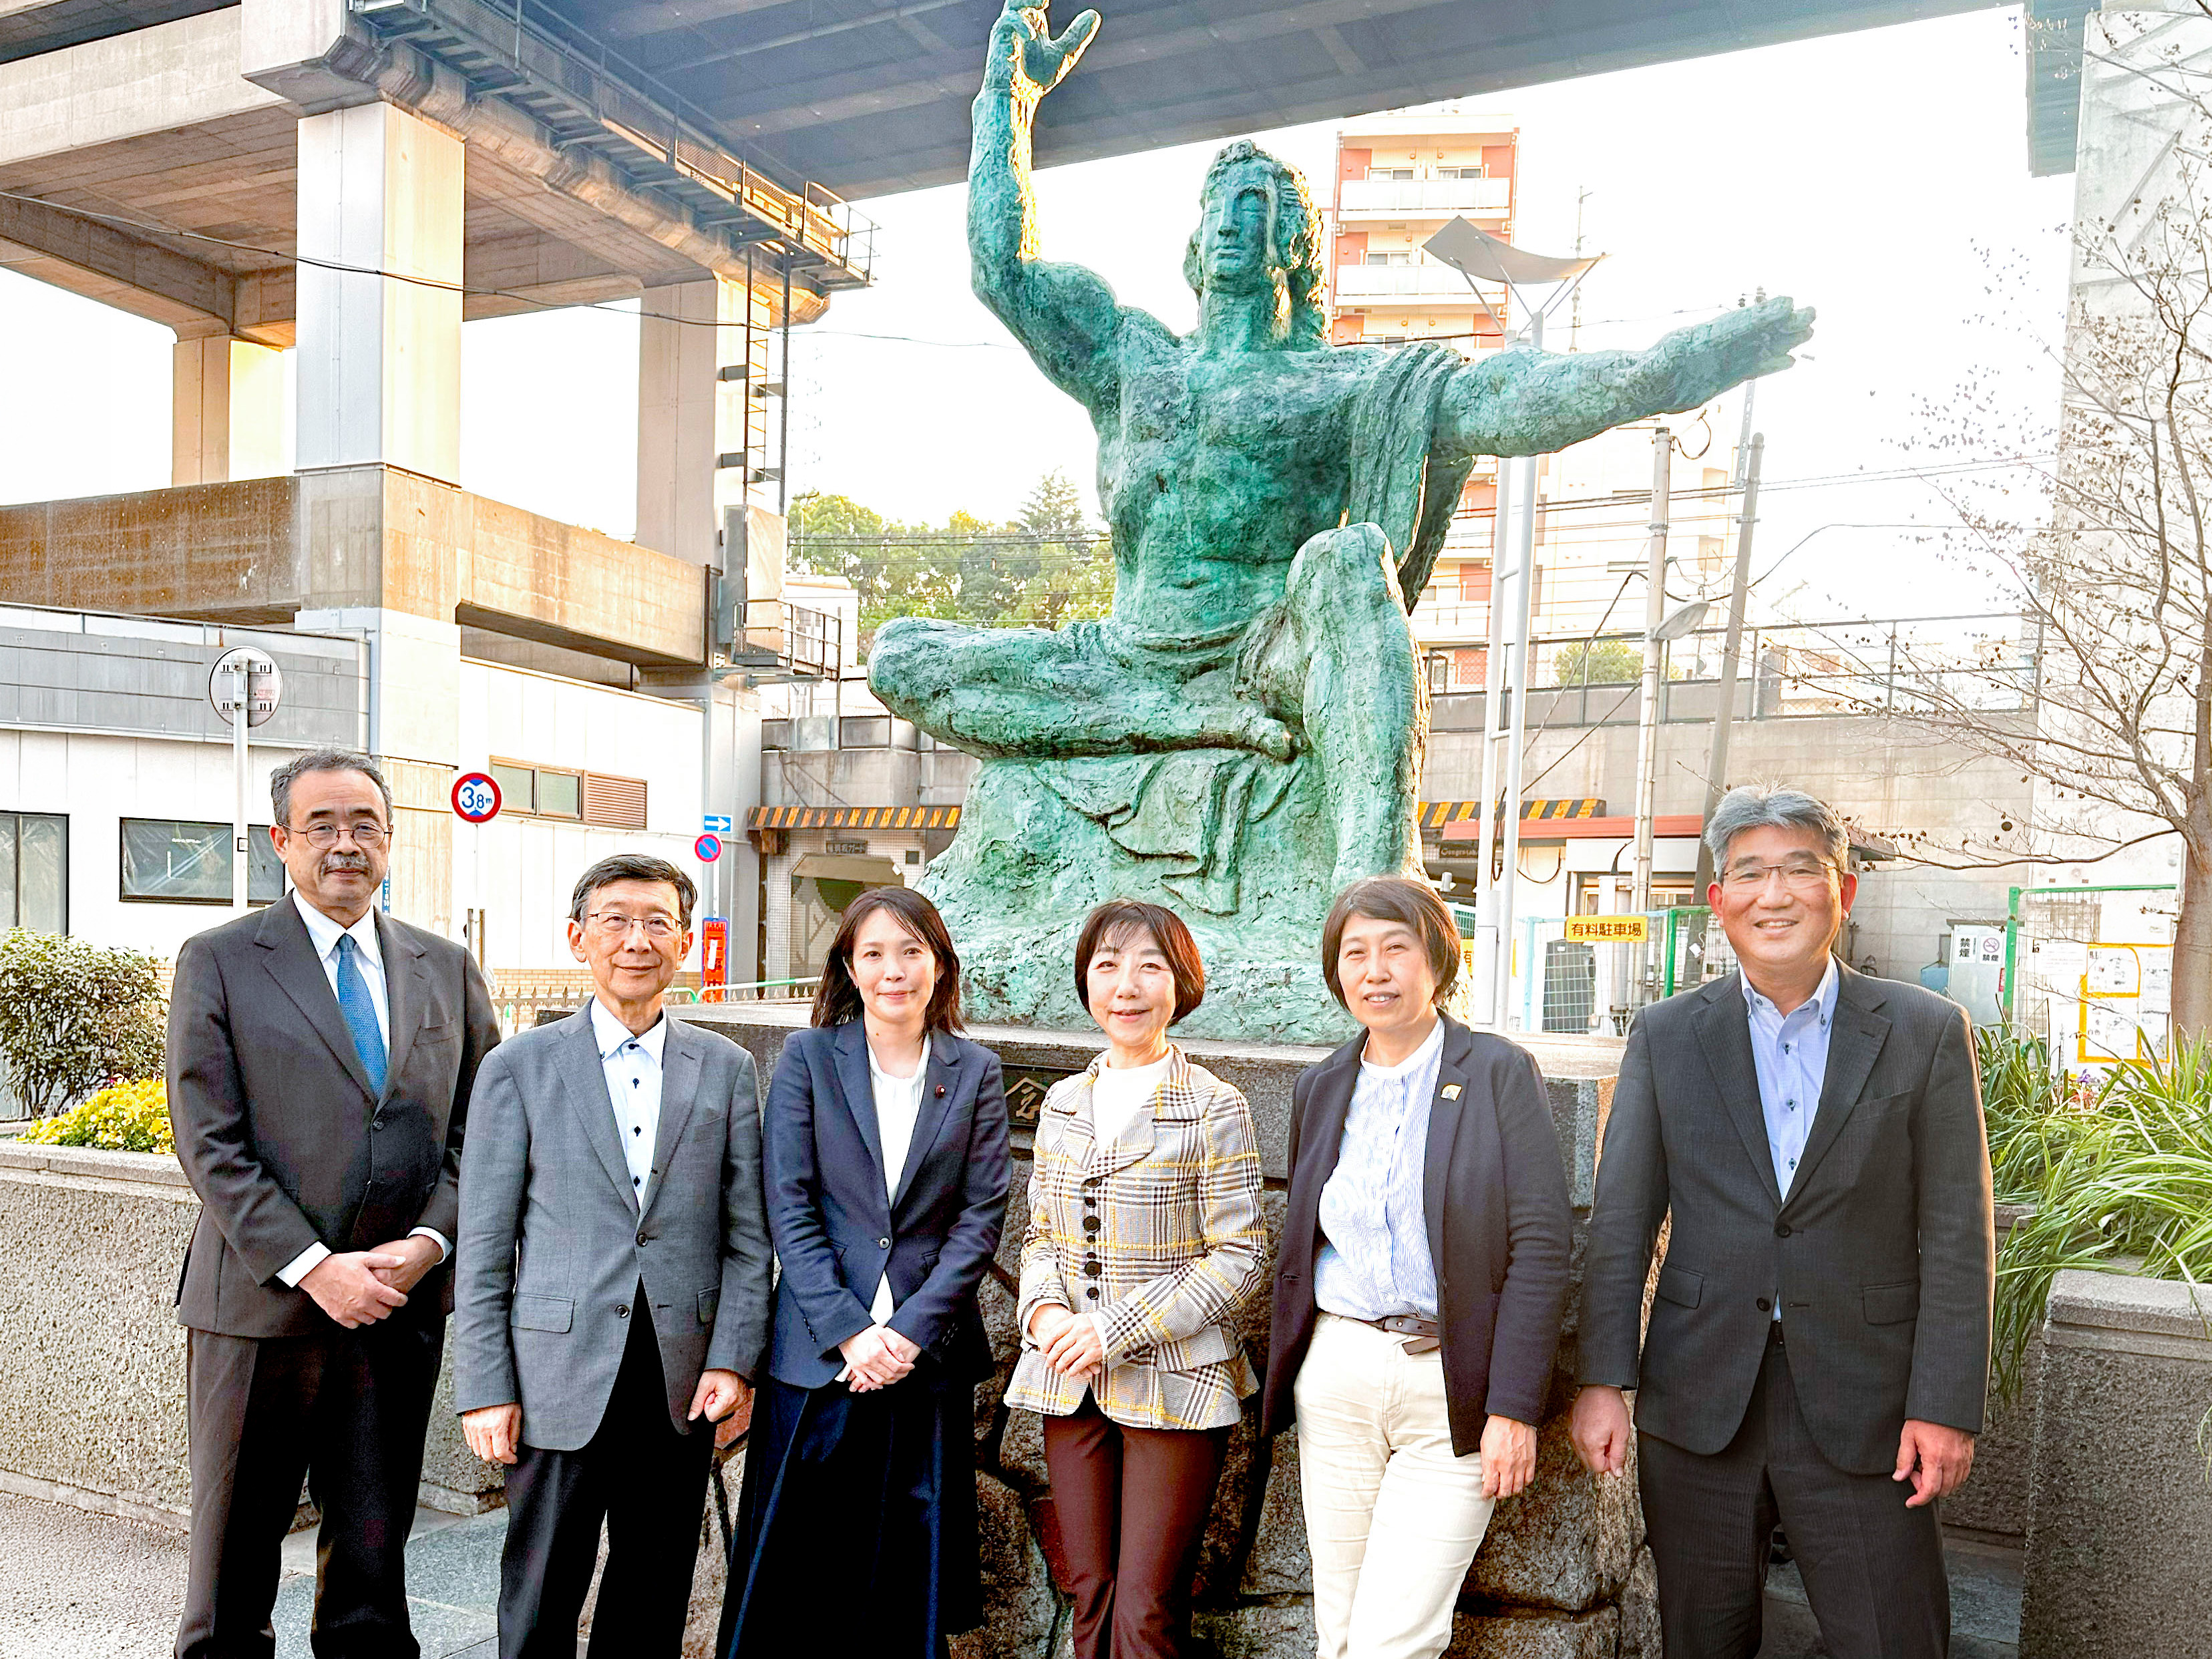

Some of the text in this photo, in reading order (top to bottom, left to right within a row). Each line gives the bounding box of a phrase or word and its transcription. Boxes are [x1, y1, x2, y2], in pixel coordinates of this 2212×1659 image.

[1571, 922, 1642, 937] 有料駐車場
[1959, 938, 1970, 958] 禁煙
[1982, 954, 1999, 962] 禁煙
